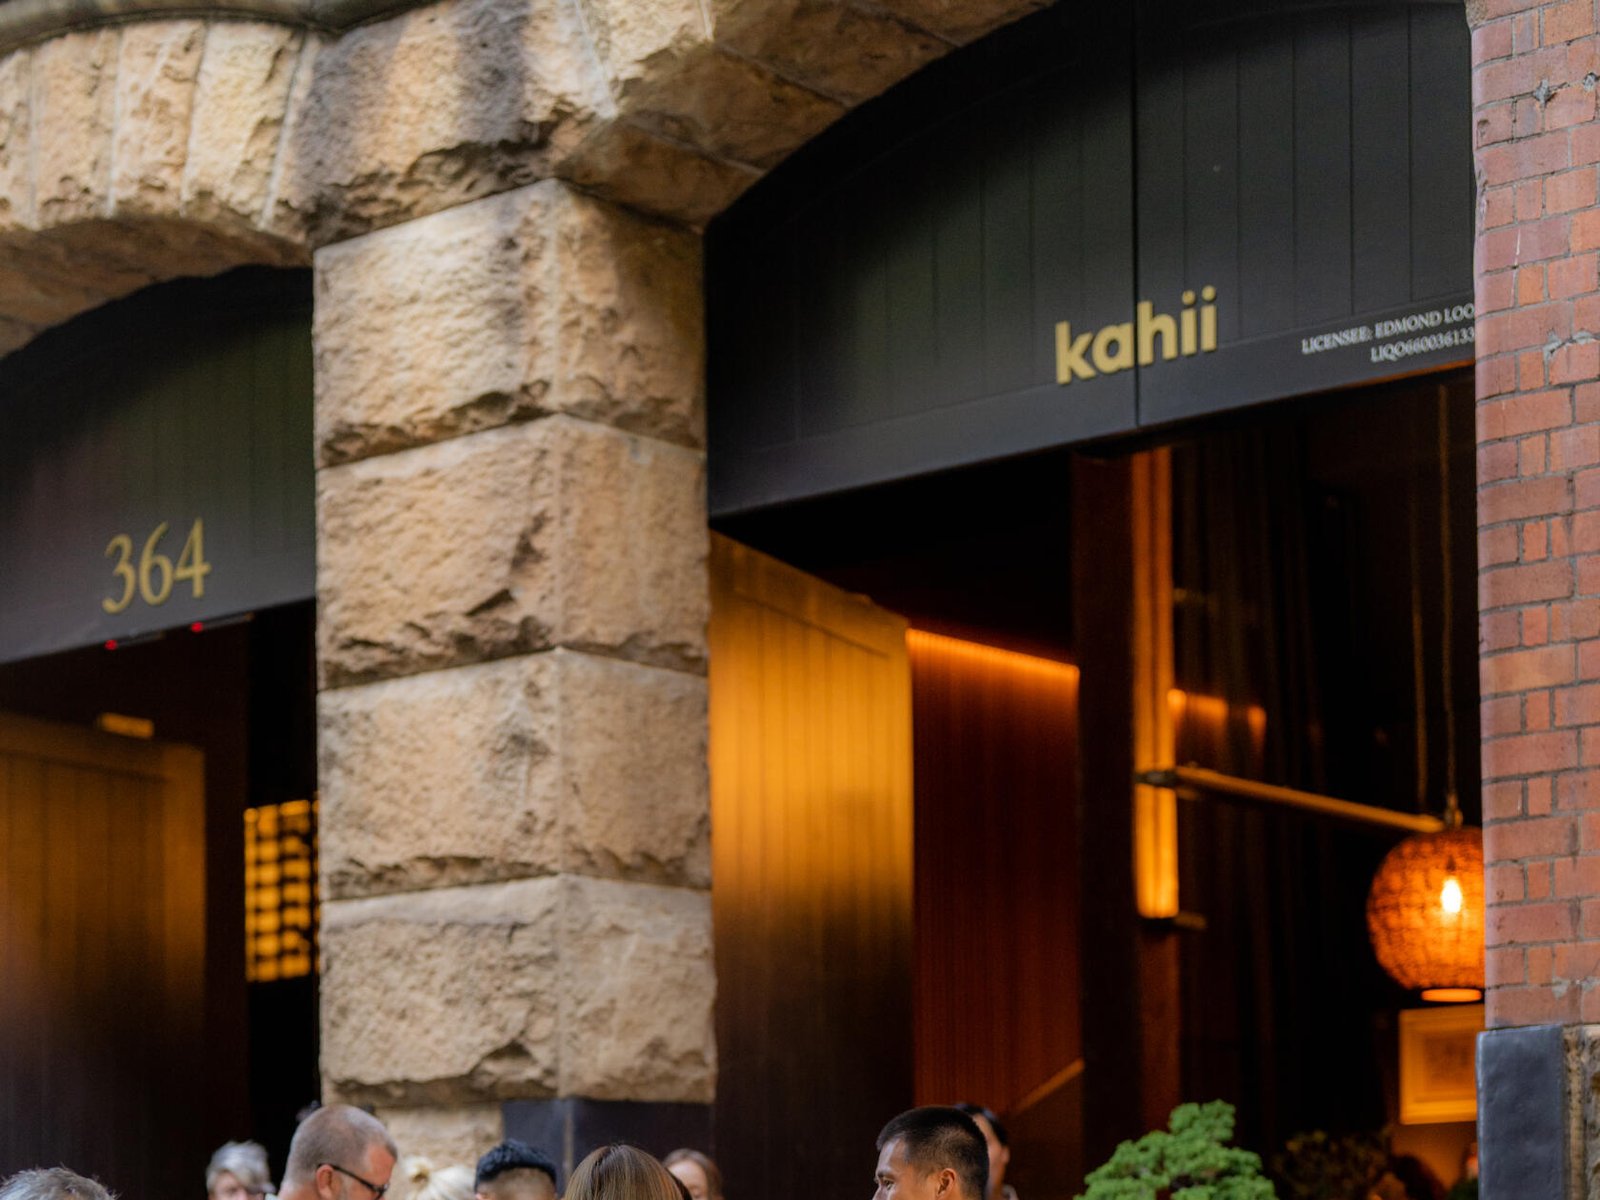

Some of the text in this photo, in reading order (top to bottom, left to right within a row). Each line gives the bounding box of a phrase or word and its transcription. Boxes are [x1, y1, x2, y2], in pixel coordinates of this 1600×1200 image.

[1055, 286, 1216, 384] kahii
[1374, 310, 1441, 339] EDMOND
[1444, 303, 1475, 324] LOO
[102, 517, 211, 614] 364
